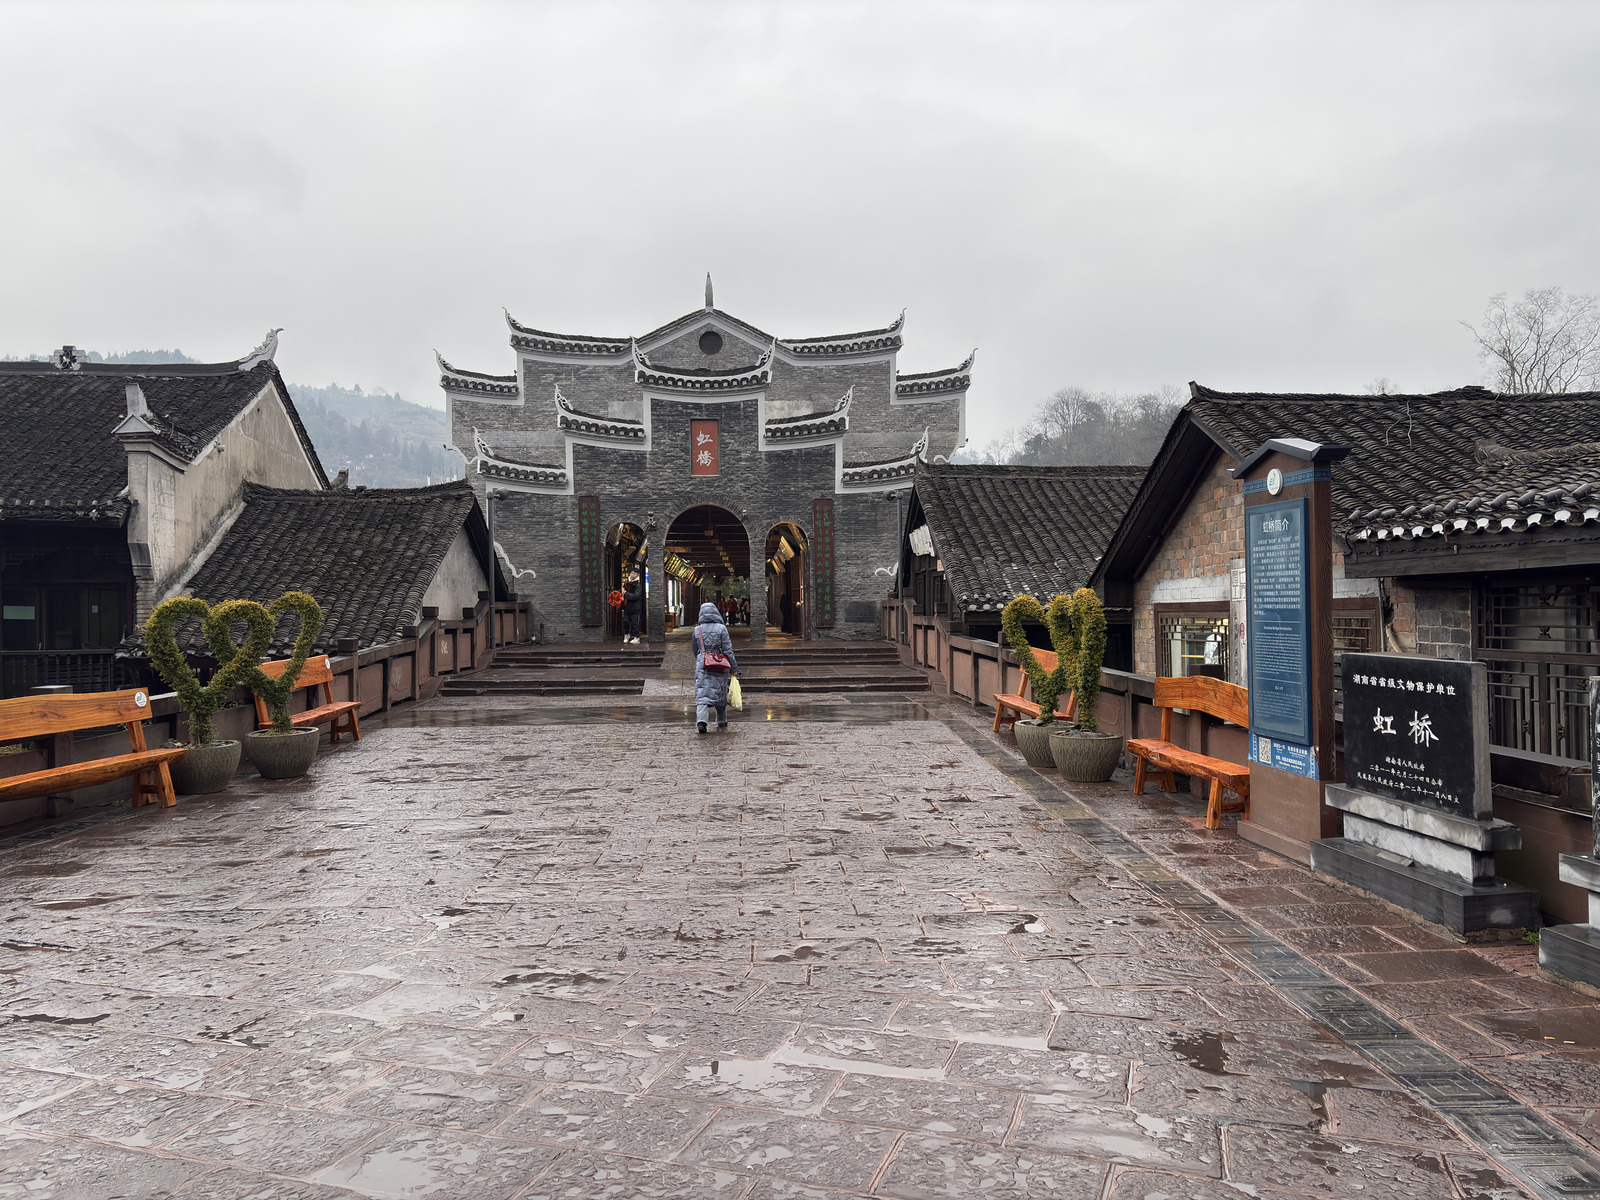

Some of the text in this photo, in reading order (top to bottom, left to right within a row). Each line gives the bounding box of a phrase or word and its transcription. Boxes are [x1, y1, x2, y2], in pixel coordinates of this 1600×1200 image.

[696, 430, 714, 467] 虹橋
[1262, 517, 1290, 533] 虹桥简介
[1353, 673, 1456, 696] 湖南省省级文物保护单位
[1373, 707, 1439, 748] 虹桥
[1385, 755, 1425, 772] 湖南省人民政府
